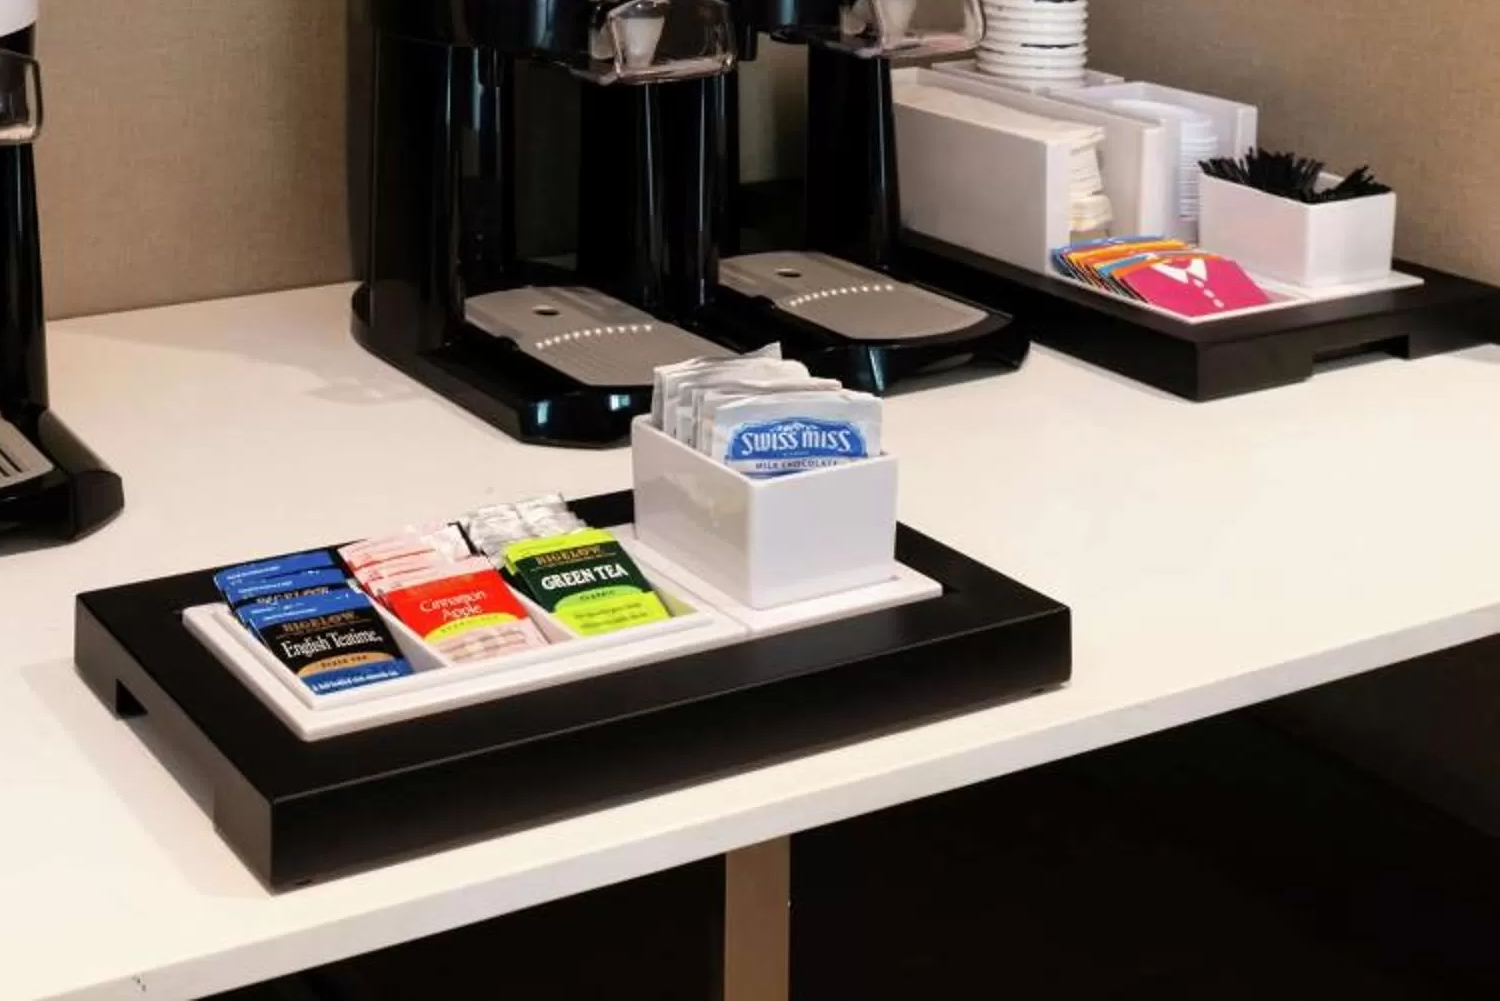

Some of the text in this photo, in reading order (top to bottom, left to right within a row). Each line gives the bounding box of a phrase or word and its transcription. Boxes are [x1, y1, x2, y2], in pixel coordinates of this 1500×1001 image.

[541, 562, 630, 591] GREEN TEA
[281, 634, 332, 658] English
